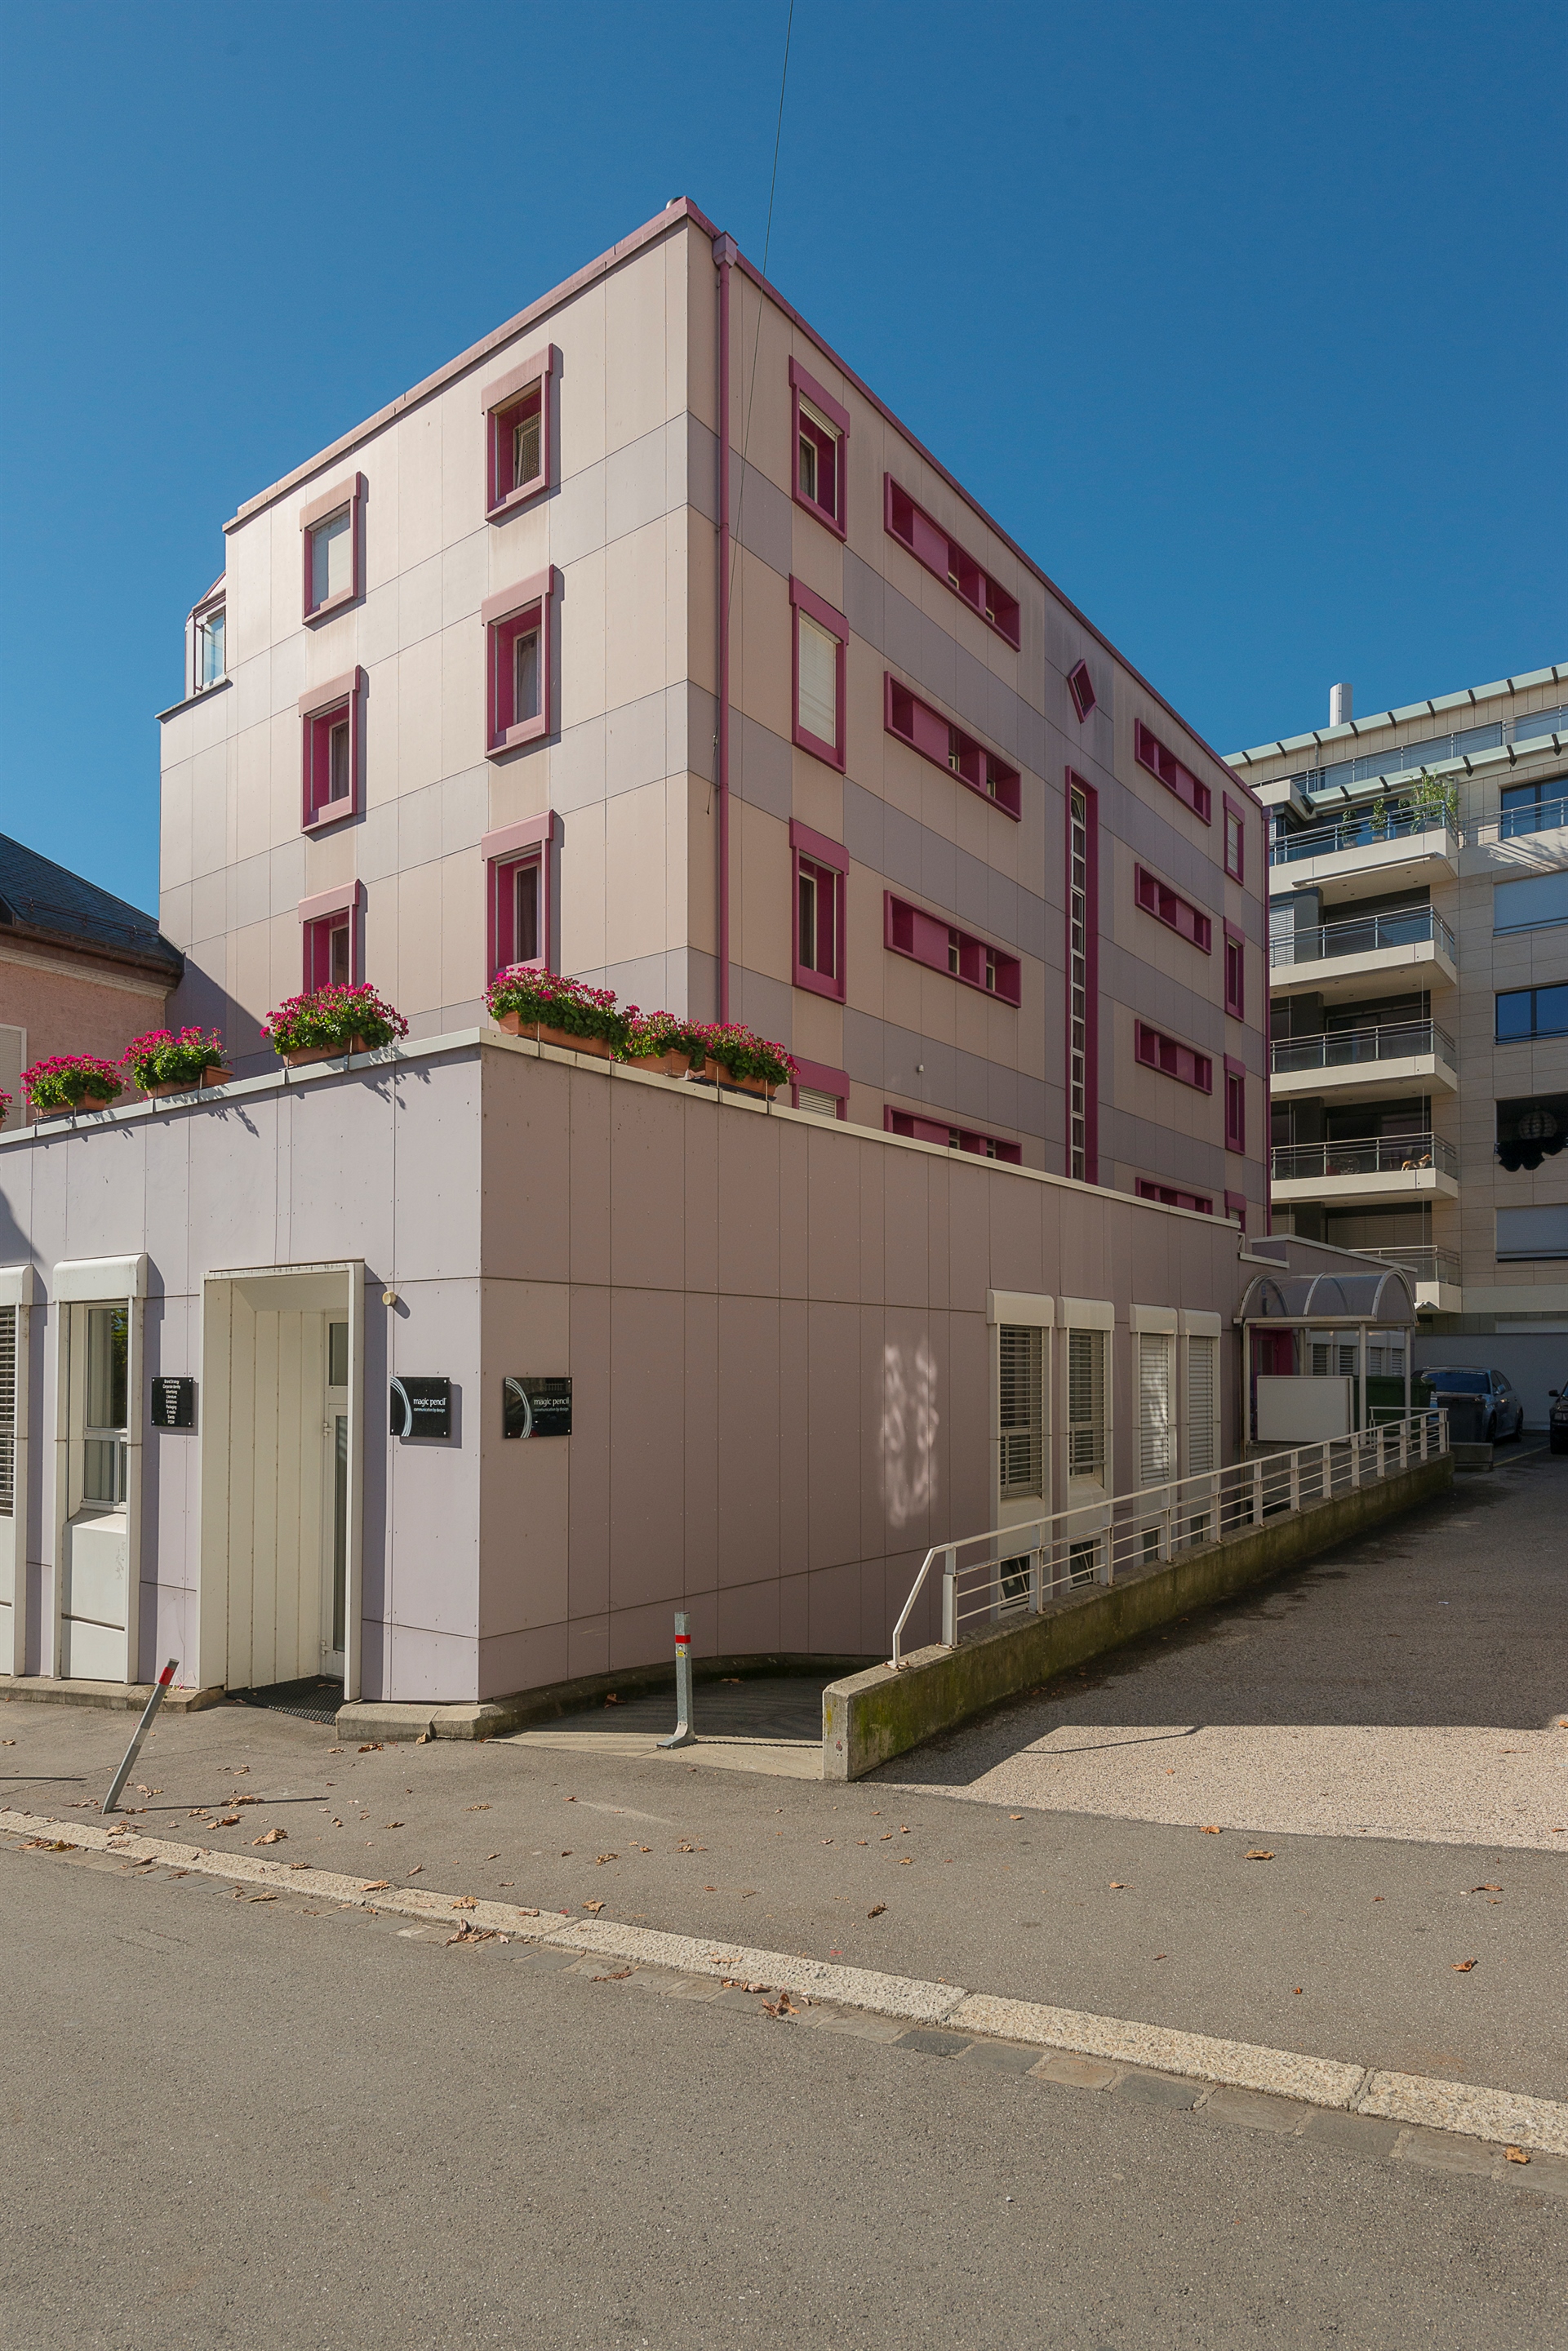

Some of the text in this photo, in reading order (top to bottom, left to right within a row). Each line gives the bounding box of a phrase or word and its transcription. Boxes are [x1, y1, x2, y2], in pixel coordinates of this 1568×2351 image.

[413, 1398, 445, 1407] magic pencil
[534, 1397, 569, 1407] magic pencil
